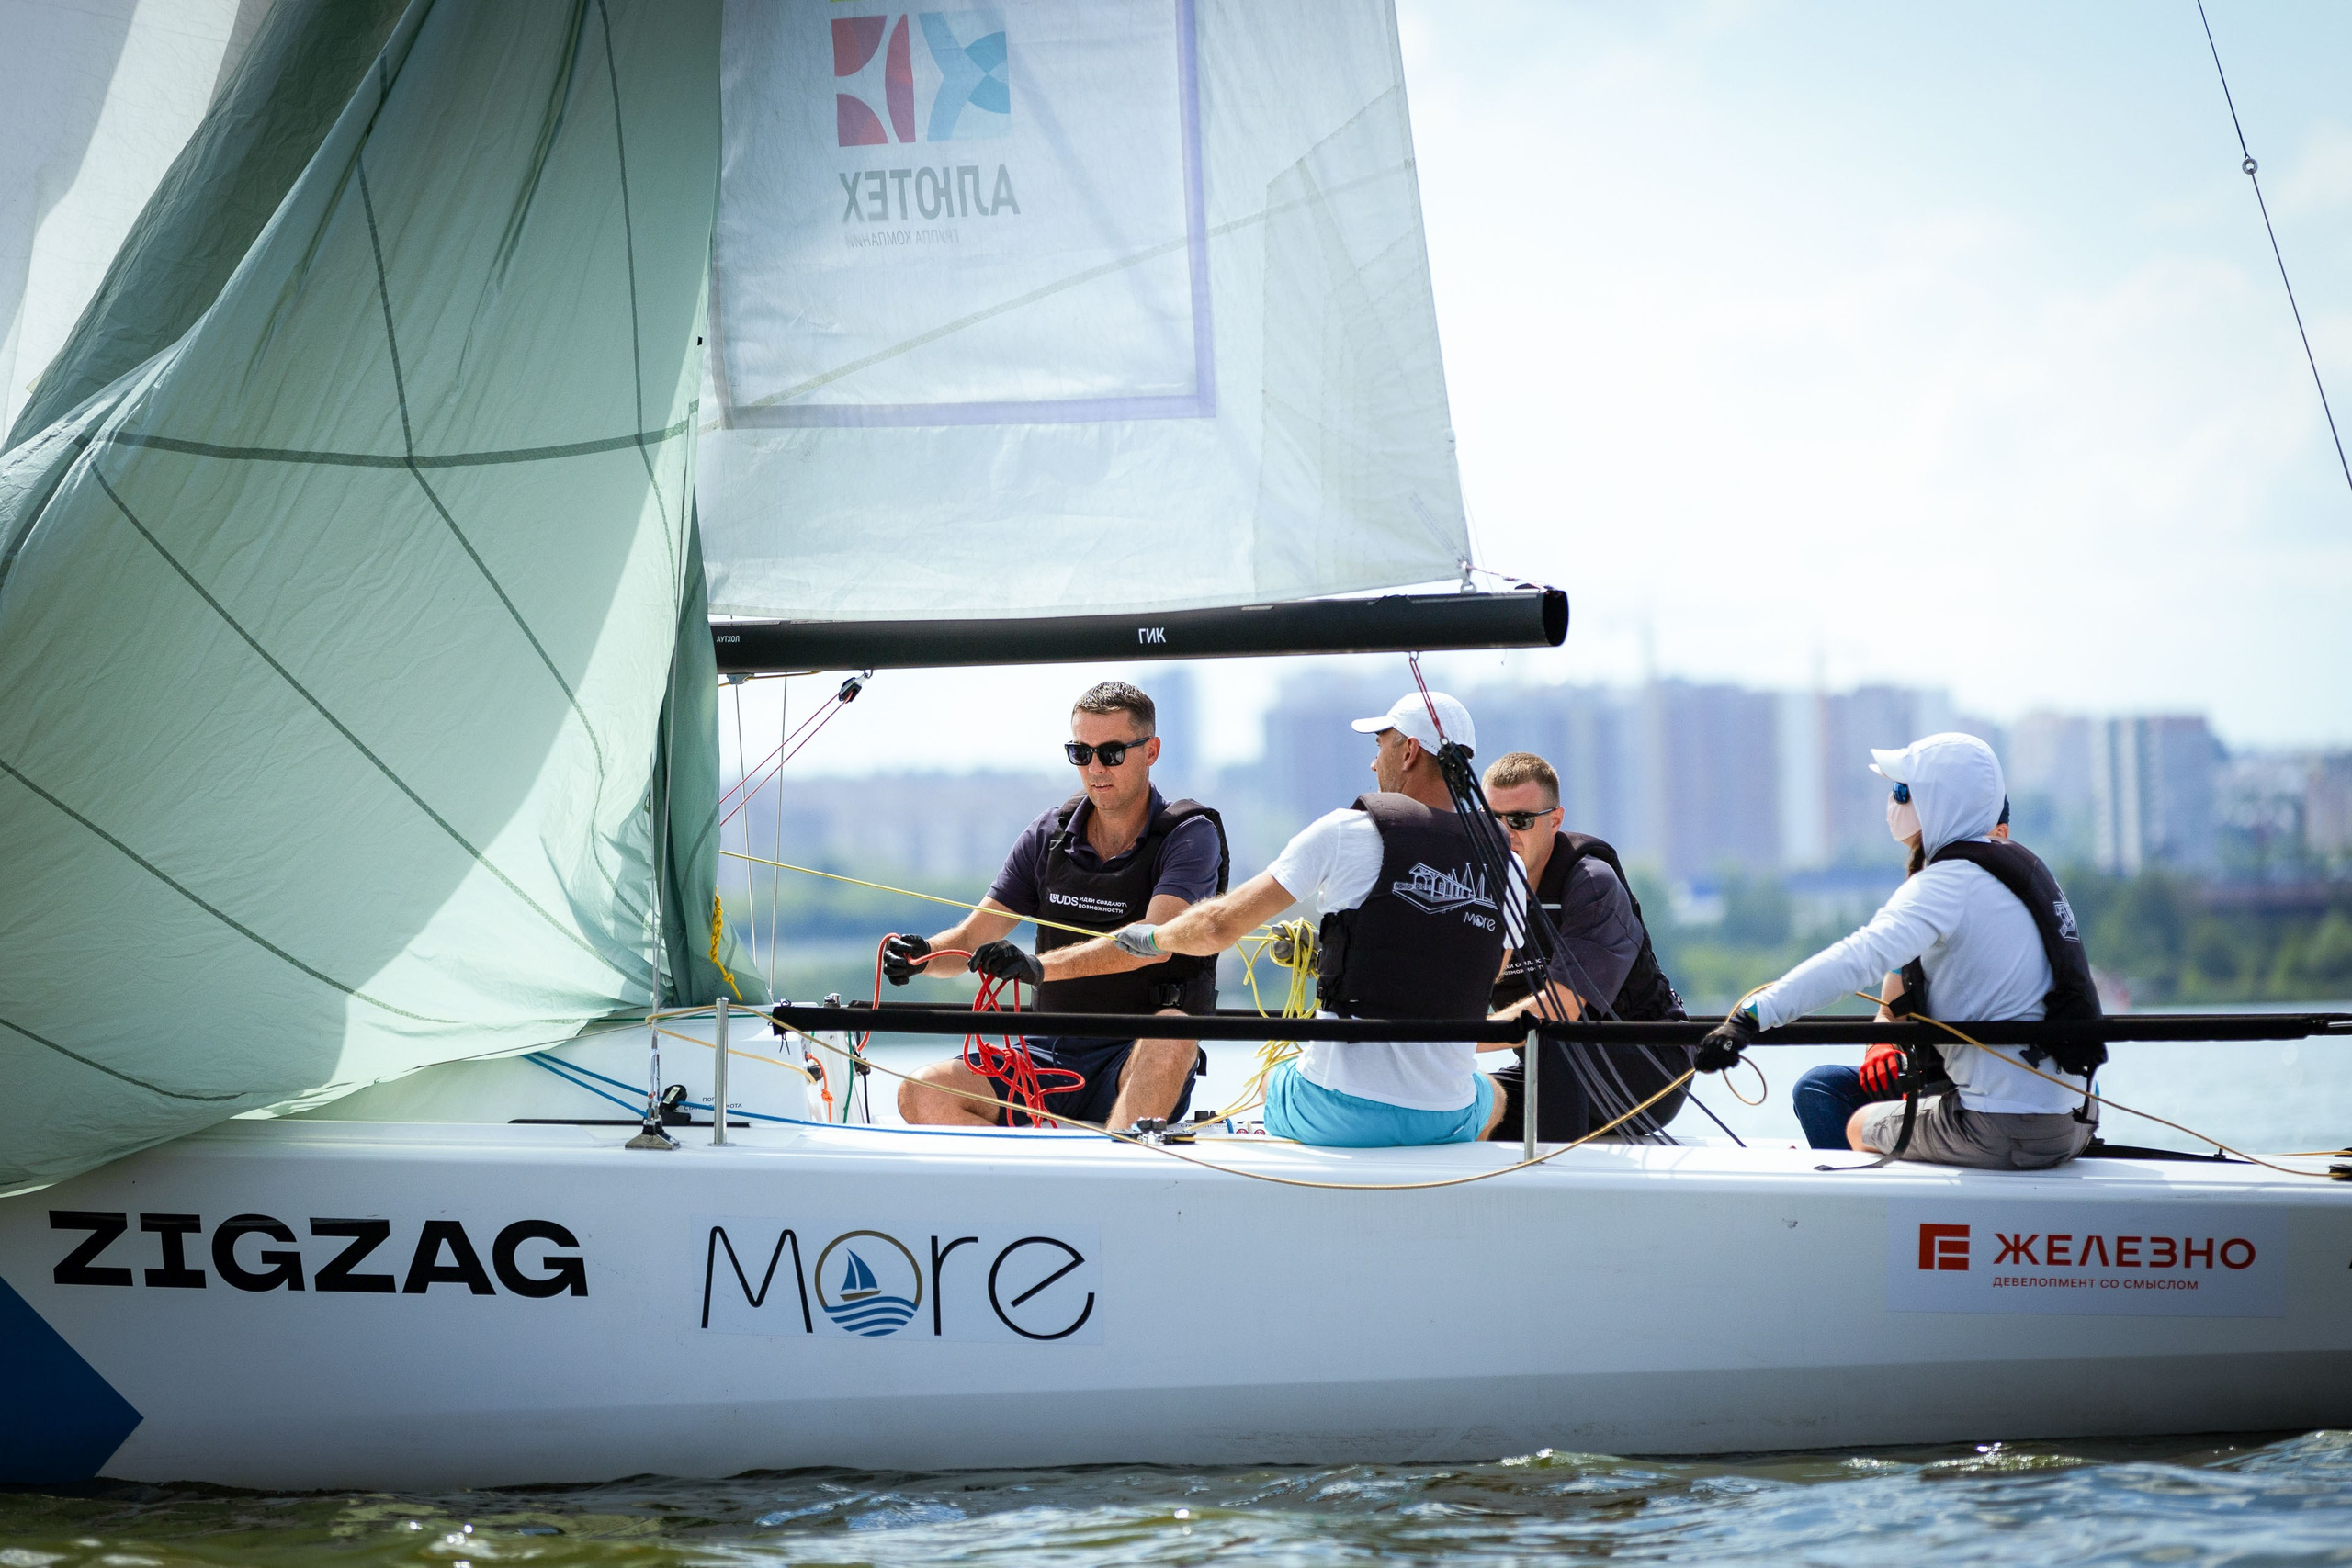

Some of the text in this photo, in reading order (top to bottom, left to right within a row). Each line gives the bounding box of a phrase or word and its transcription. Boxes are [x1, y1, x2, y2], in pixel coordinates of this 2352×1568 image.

[716, 635, 741, 643] АУТХОЛ
[1138, 627, 1166, 644] ГИК
[1079, 903, 1124, 914] ВОЗМОЖНОСТИ
[1096, 899, 1125, 908] СОЗДАЮТ
[49, 1210, 589, 1298] ZIGZAG
[1993, 1233, 2256, 1269] ЖЕЛЕЗНО
[1992, 1277, 2199, 1290] ДЕВЕЛОПМЕНТ СО СМЫСЛОМ
